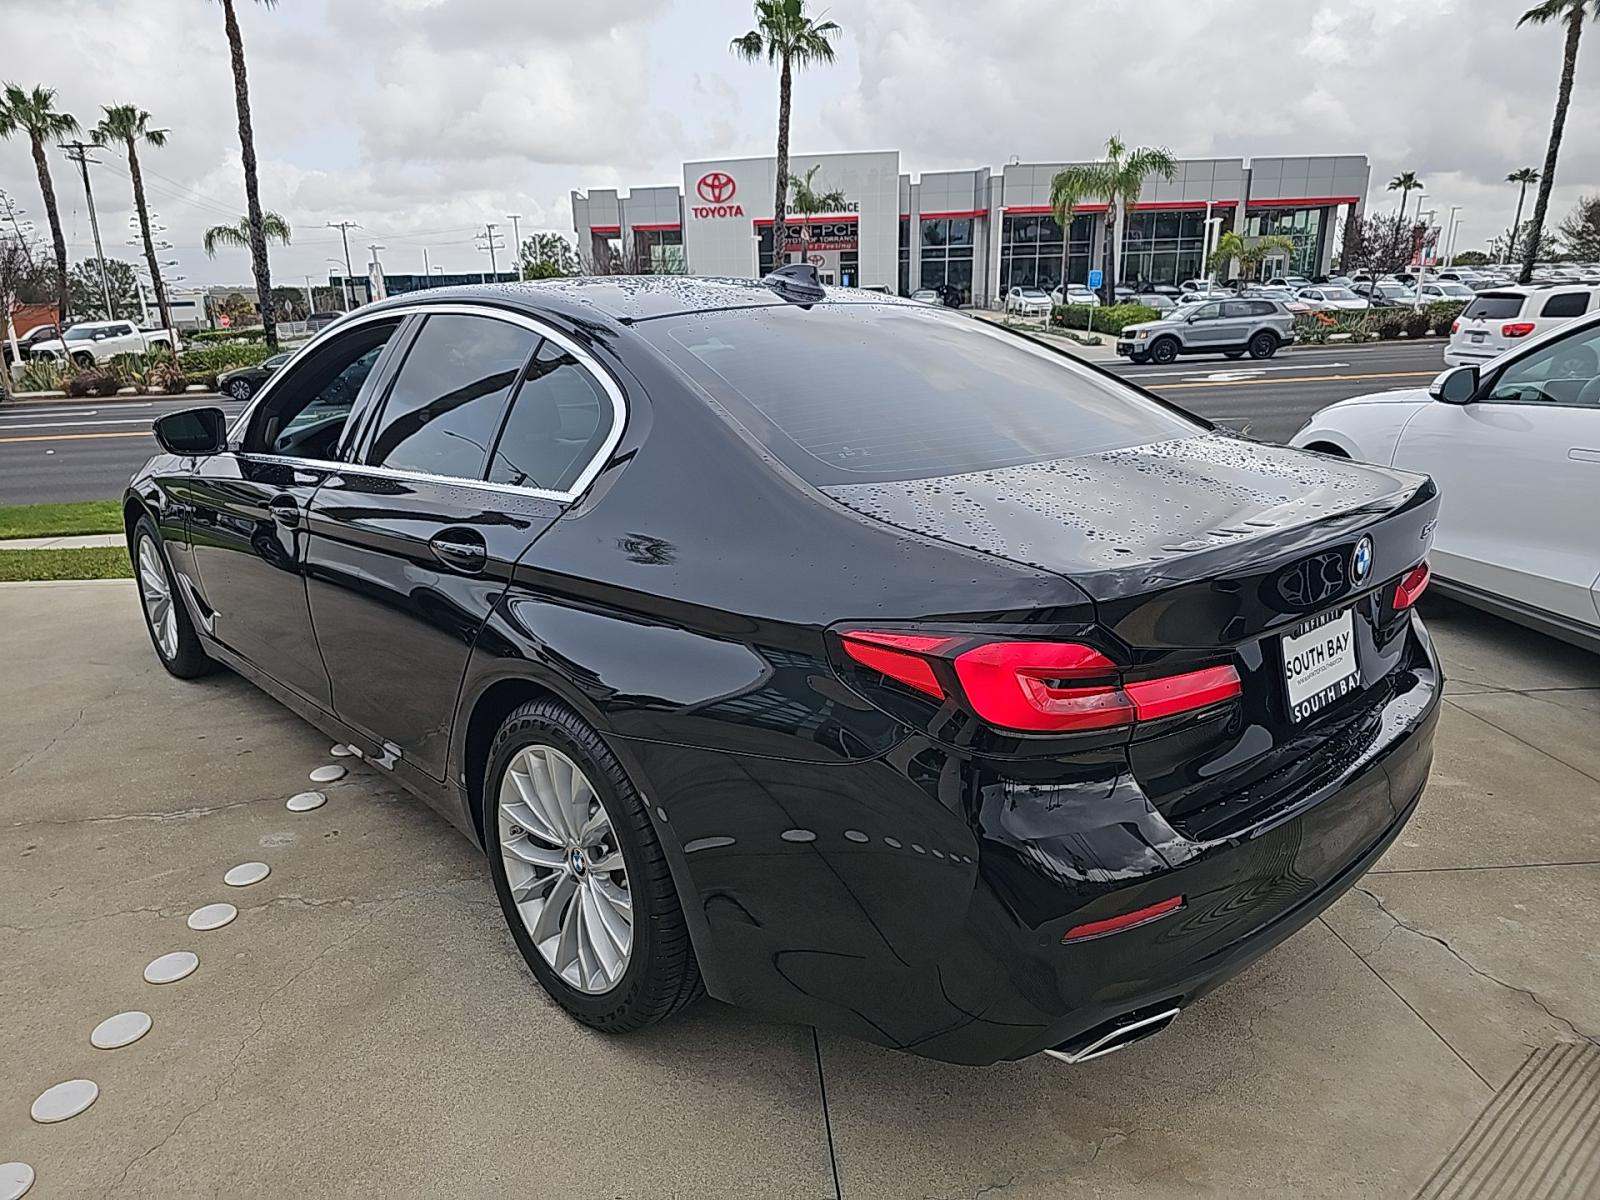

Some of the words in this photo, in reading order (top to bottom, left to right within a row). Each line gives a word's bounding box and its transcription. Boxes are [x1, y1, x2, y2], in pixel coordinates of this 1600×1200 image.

[692, 205, 744, 219] TOYOTA
[1300, 609, 1339, 634] INFINITI
[1286, 644, 1325, 680] SOUTH
[1327, 631, 1350, 658] BAY
[1294, 687, 1336, 723] SOUTH
[1340, 670, 1361, 696] BAY
